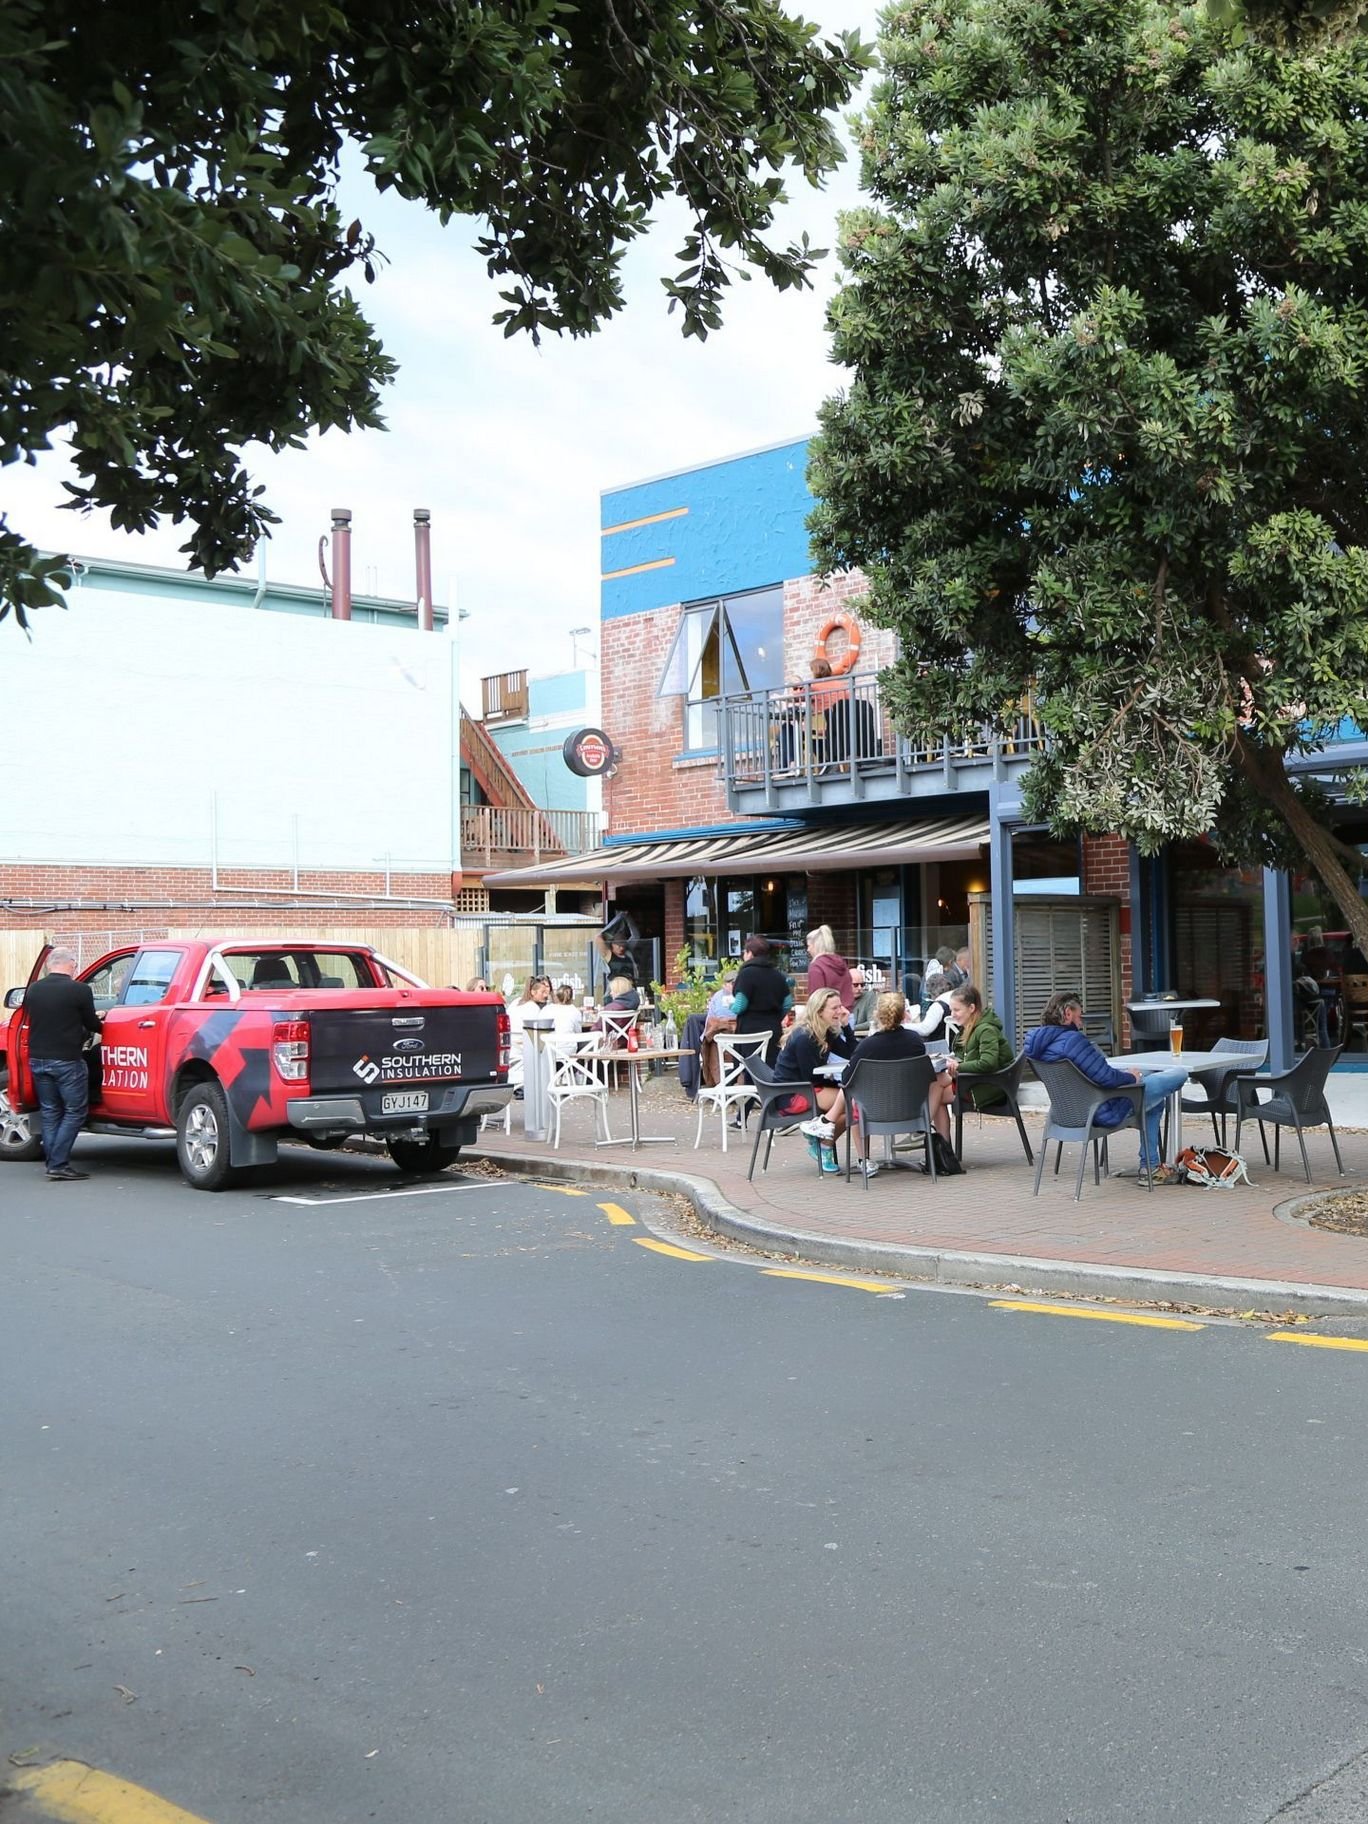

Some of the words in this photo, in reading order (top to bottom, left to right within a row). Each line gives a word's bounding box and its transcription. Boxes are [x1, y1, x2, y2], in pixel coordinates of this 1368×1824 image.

[100, 1045, 148, 1067] THERN
[382, 1053, 462, 1068] SOUTHERN
[101, 1069, 148, 1088] LATION
[382, 1065, 462, 1079] INSULATION
[383, 1095, 427, 1109] GYJ147
